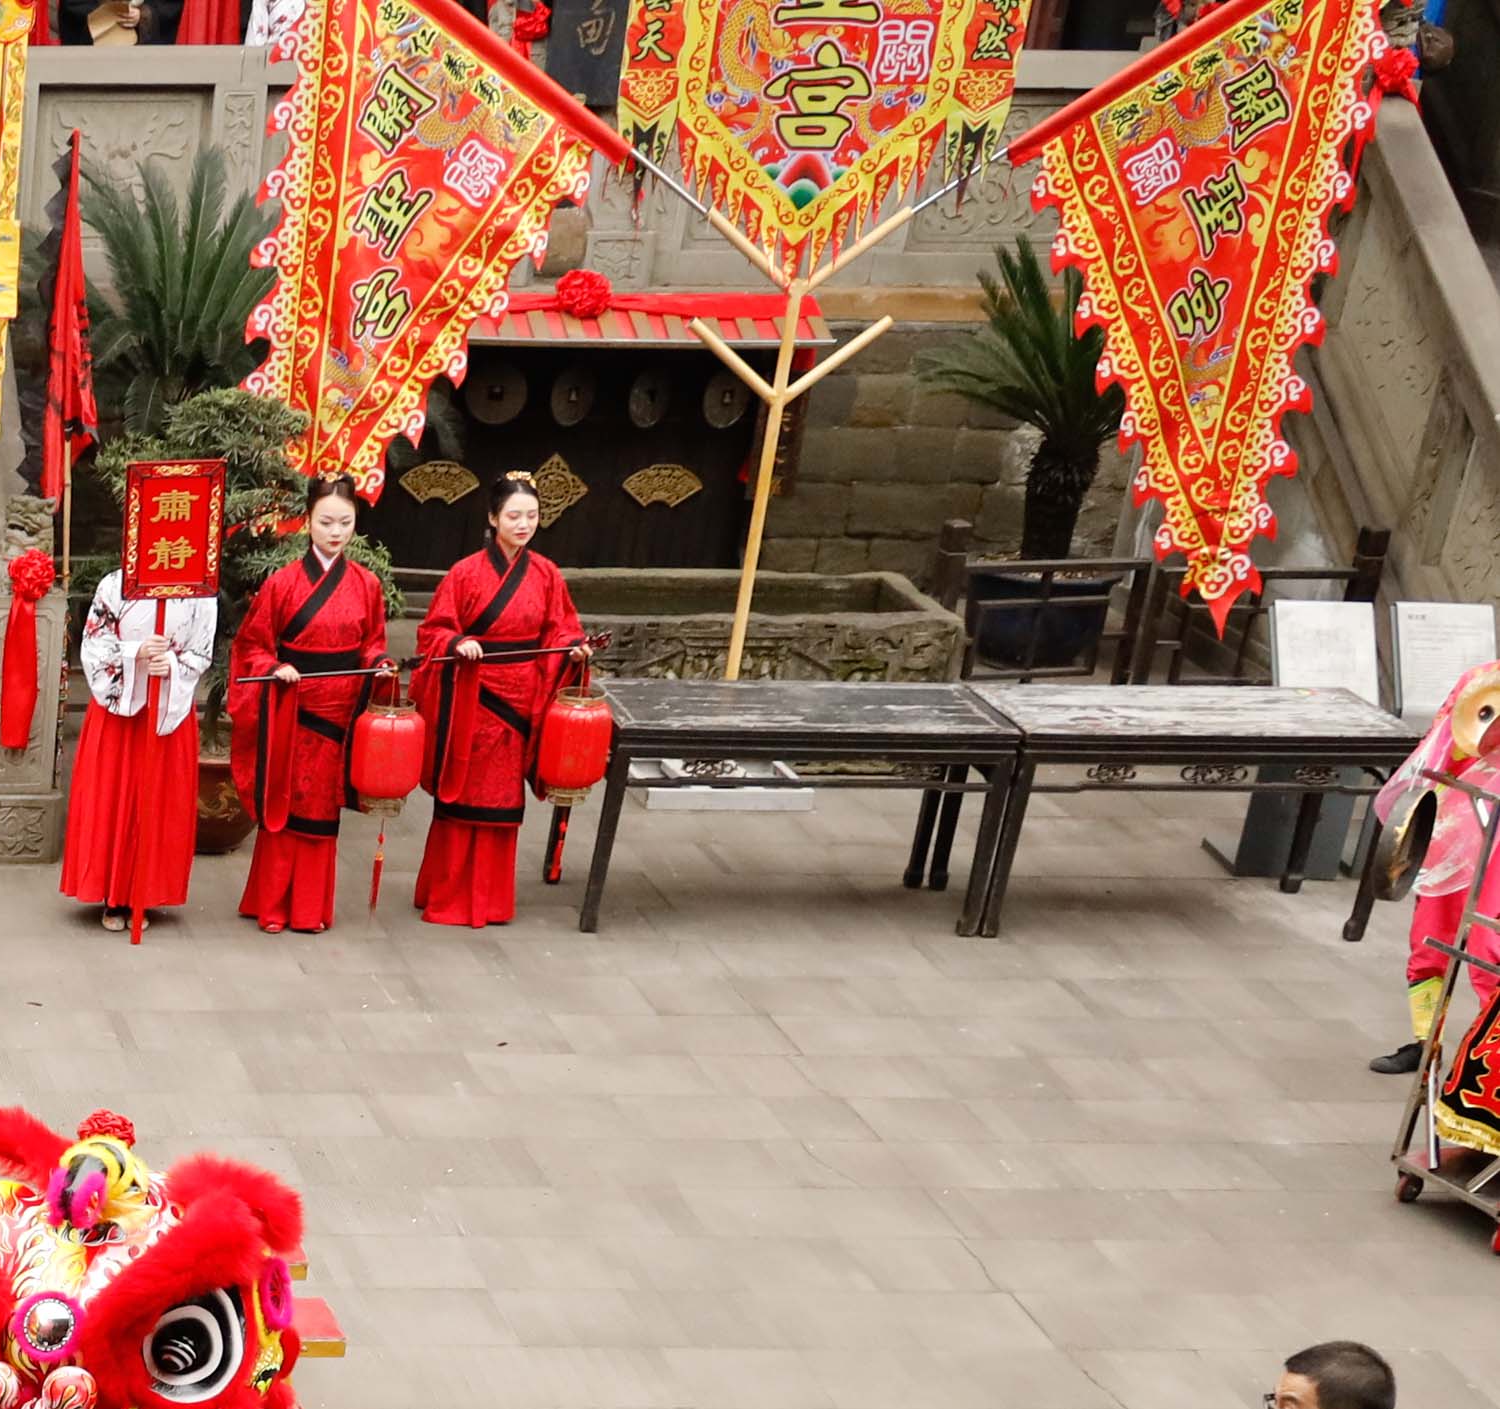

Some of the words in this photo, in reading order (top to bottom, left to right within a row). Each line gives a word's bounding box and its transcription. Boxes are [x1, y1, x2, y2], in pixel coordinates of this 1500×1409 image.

[350, 62, 439, 340] 關聖宮
[1166, 59, 1292, 340] 關聖宮
[148, 489, 201, 571] 肅靜
